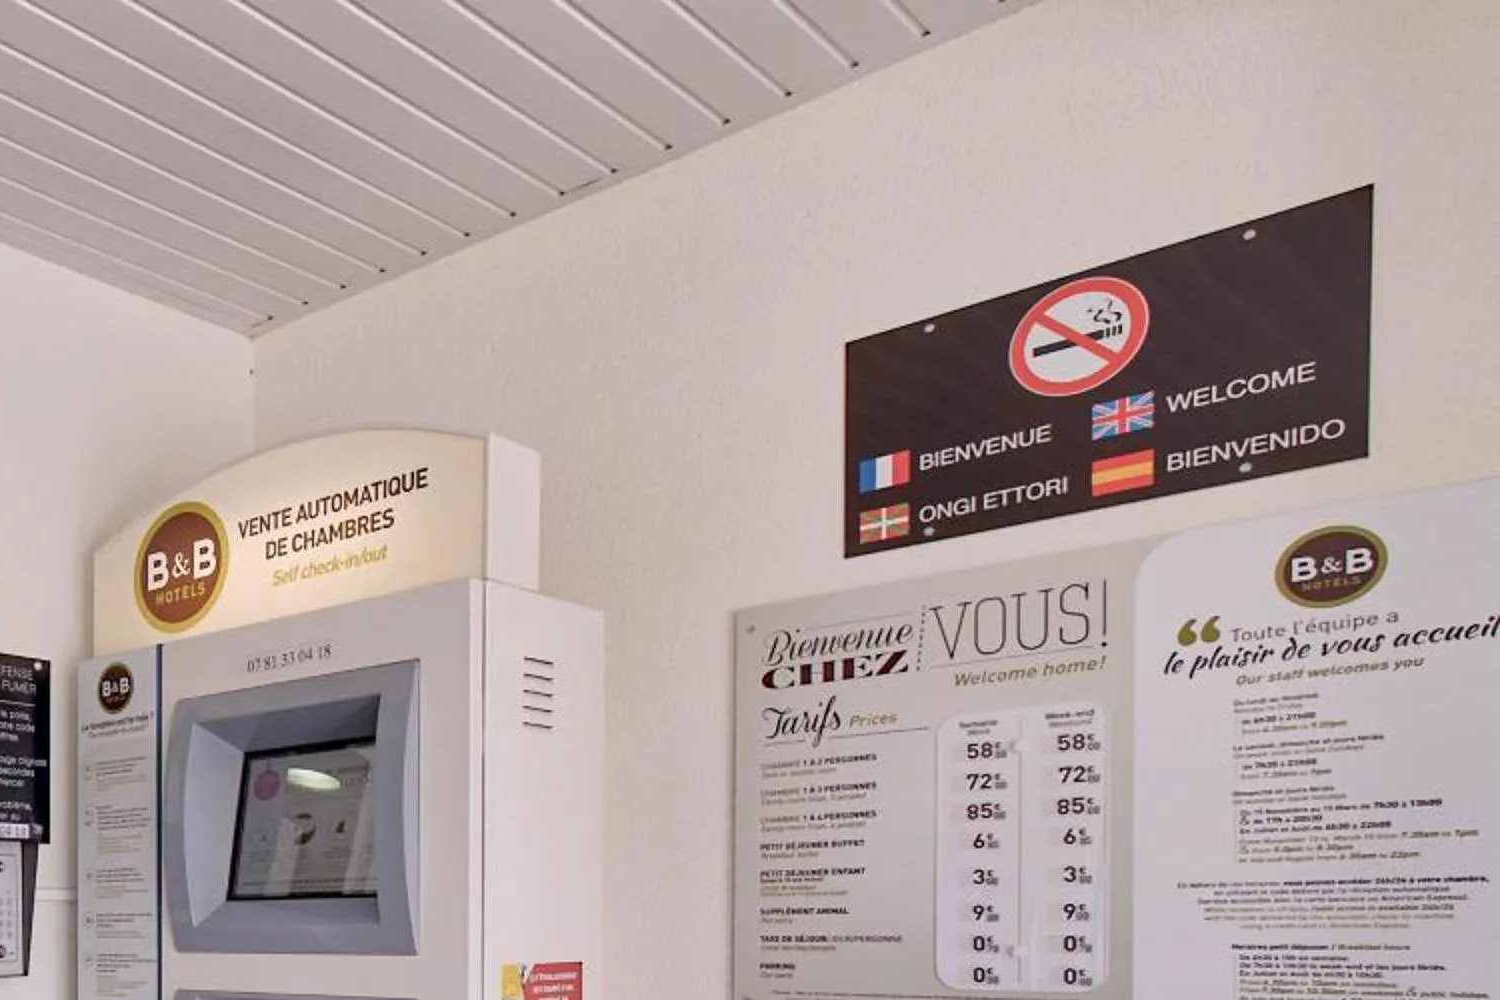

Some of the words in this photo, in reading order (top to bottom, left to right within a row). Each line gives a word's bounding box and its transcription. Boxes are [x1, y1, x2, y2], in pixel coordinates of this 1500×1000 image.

[1166, 362, 1317, 413] WELCOME
[919, 425, 1052, 471] BIENVENUE
[1167, 419, 1346, 472] BIENVENIDO
[237, 507, 293, 538] VENTE
[296, 468, 429, 524] AUTOMATIQUE
[919, 496, 976, 524] ONGI
[983, 477, 1068, 511] ETTORI
[266, 537, 287, 561] DE
[292, 508, 394, 553] CHAMBRES
[147, 538, 216, 591] B&B
[1291, 547, 1372, 583] B&B
[1302, 578, 1361, 592] HOTELS
[156, 581, 204, 604] HOTELS
[929, 580, 1108, 659] VOUS!
[1231, 625, 1286, 642] Toute
[764, 620, 913, 666] Bienvenue
[1163, 651, 1183, 675] le
[1190, 645, 1274, 679] plaisir
[1281, 637, 1308, 662] de
[1320, 632, 1386, 656] vous
[2, 679, 37, 695] FUMER
[761, 650, 908, 689] CHEZ
[954, 666, 1037, 688] Welcome
[1042, 655, 1107, 678] home!
[1235, 672, 1262, 686] Our
[1268, 669, 1302, 682] staff
[1308, 659, 1388, 679] welcomes
[1393, 656, 1424, 671] you
[762, 696, 841, 748] Tarifs
[850, 711, 898, 728] Prices
